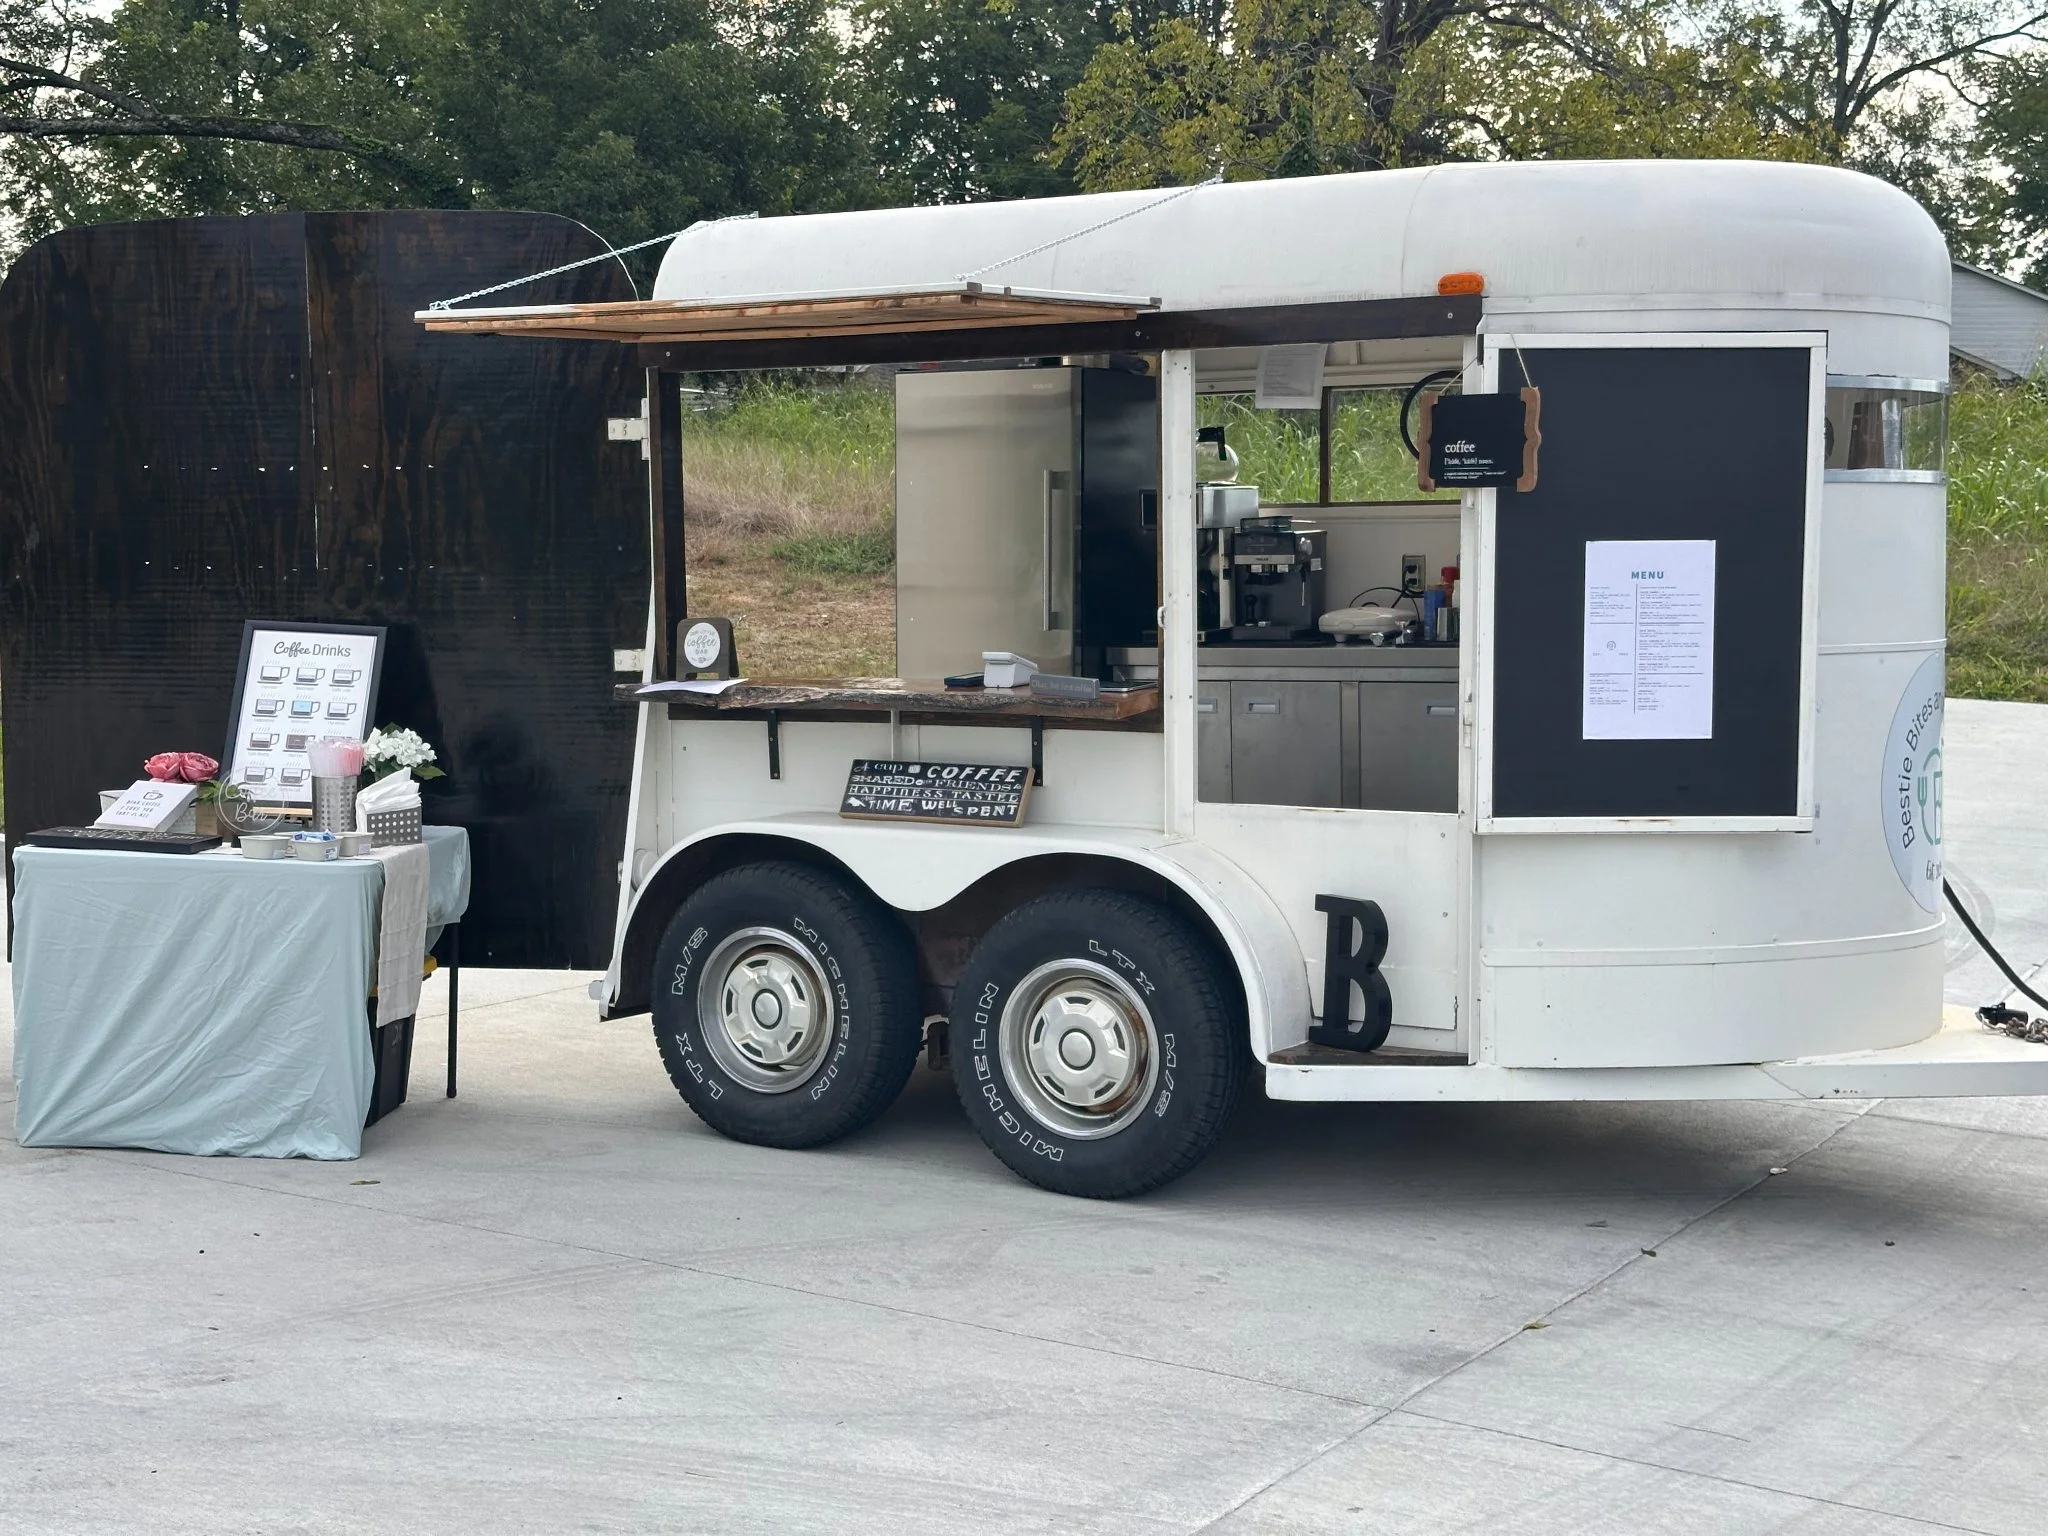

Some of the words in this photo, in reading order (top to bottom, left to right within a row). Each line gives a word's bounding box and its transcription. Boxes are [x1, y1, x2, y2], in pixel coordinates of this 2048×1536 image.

[1444, 440, 1476, 453] coffee
[1631, 571, 1665, 580] MENU
[273, 641, 312, 658] Coffee
[312, 643, 352, 658] Drinks
[686, 635, 718, 649] coffee
[1906, 698, 1933, 752] Bites
[874, 763, 903, 774] cup
[927, 765, 1023, 782] COFFEE
[851, 775, 915, 786] SHARED
[935, 779, 1012, 792] FRIENDS
[849, 785, 943, 798] HAPPINESS
[952, 791, 1020, 803] TASTED
[1898, 757, 1915, 849] Bestie
[235, 801, 268, 823] Bar
[869, 798, 915, 812] TIME
[922, 800, 957, 810] WELL
[953, 805, 1018, 817] SPENT
[671, 926, 709, 996] M/S
[1308, 893, 1393, 1053] B
[794, 917, 850, 1100] MICHELIN
[973, 982, 1064, 1162] MICHELIN
[1088, 939, 1156, 996] LTX
[1155, 1033, 1177, 1117] M/S
[675, 1032, 724, 1100] LTX
